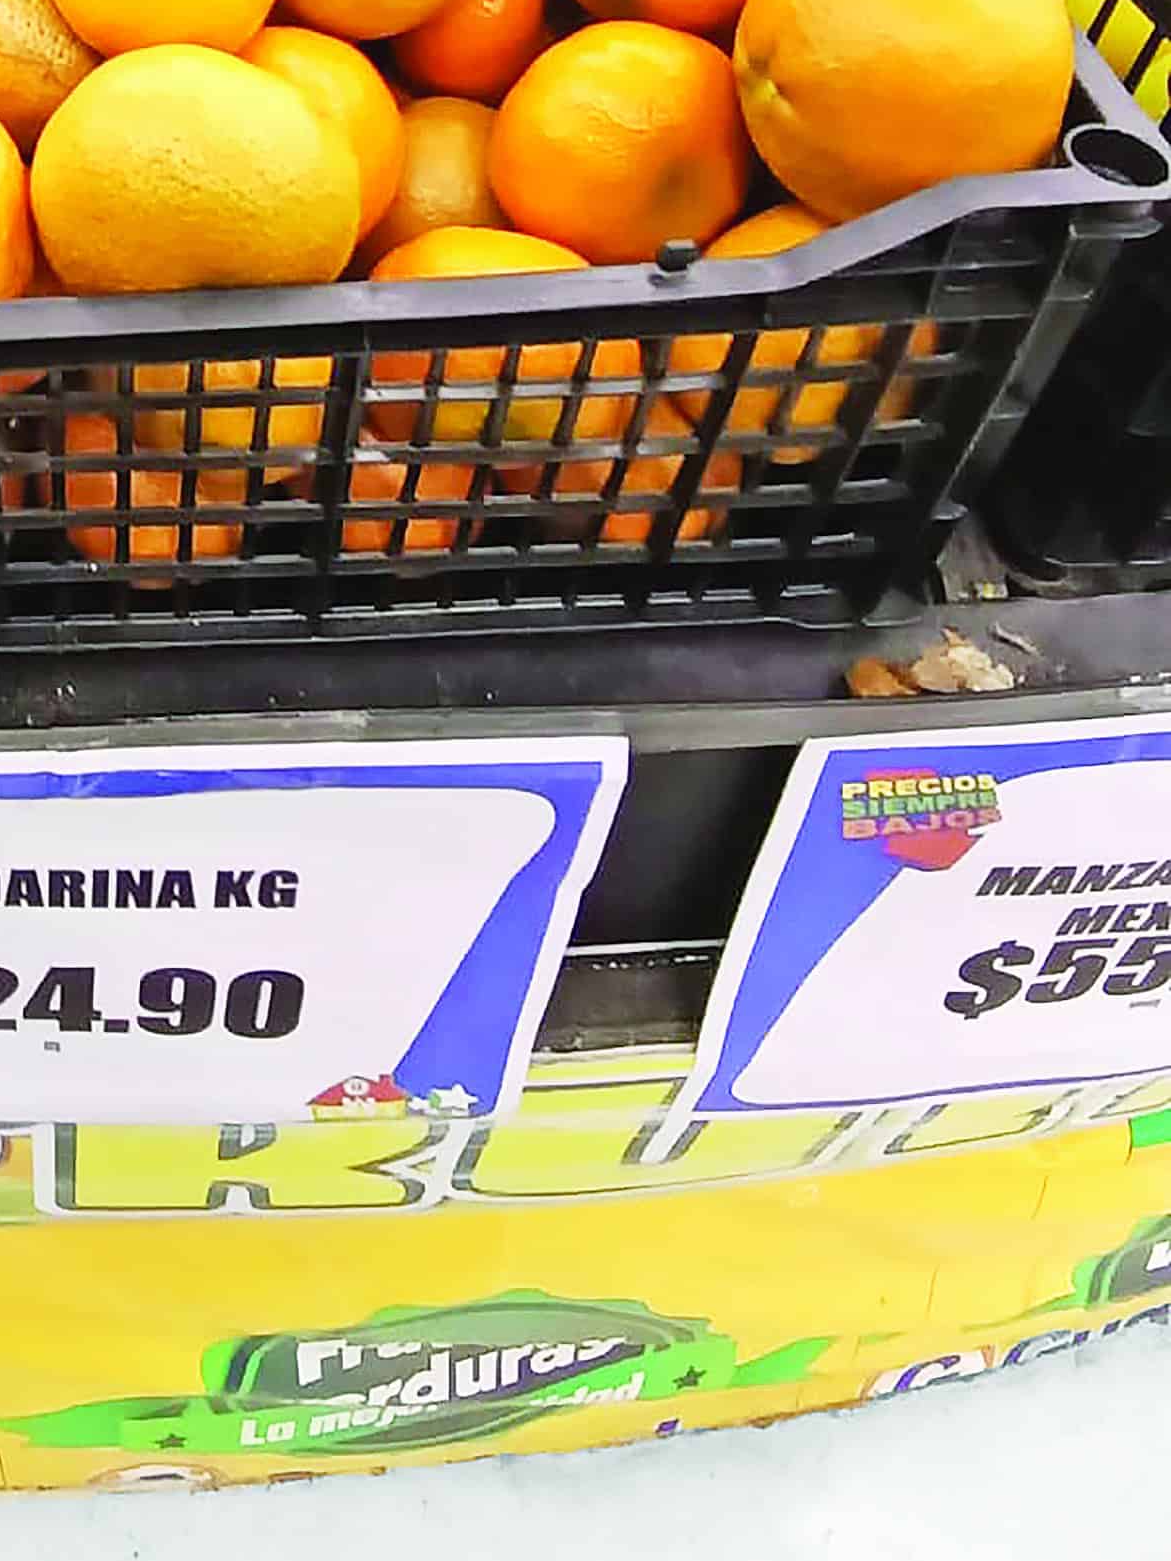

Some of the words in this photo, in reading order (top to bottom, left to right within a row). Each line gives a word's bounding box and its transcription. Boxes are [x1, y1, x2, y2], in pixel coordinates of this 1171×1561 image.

[841, 774, 997, 799] PRECIOS
[842, 791, 1000, 819] SIEMPRE
[842, 808, 1003, 840] BAJOS
[213, 870, 301, 909] KG
